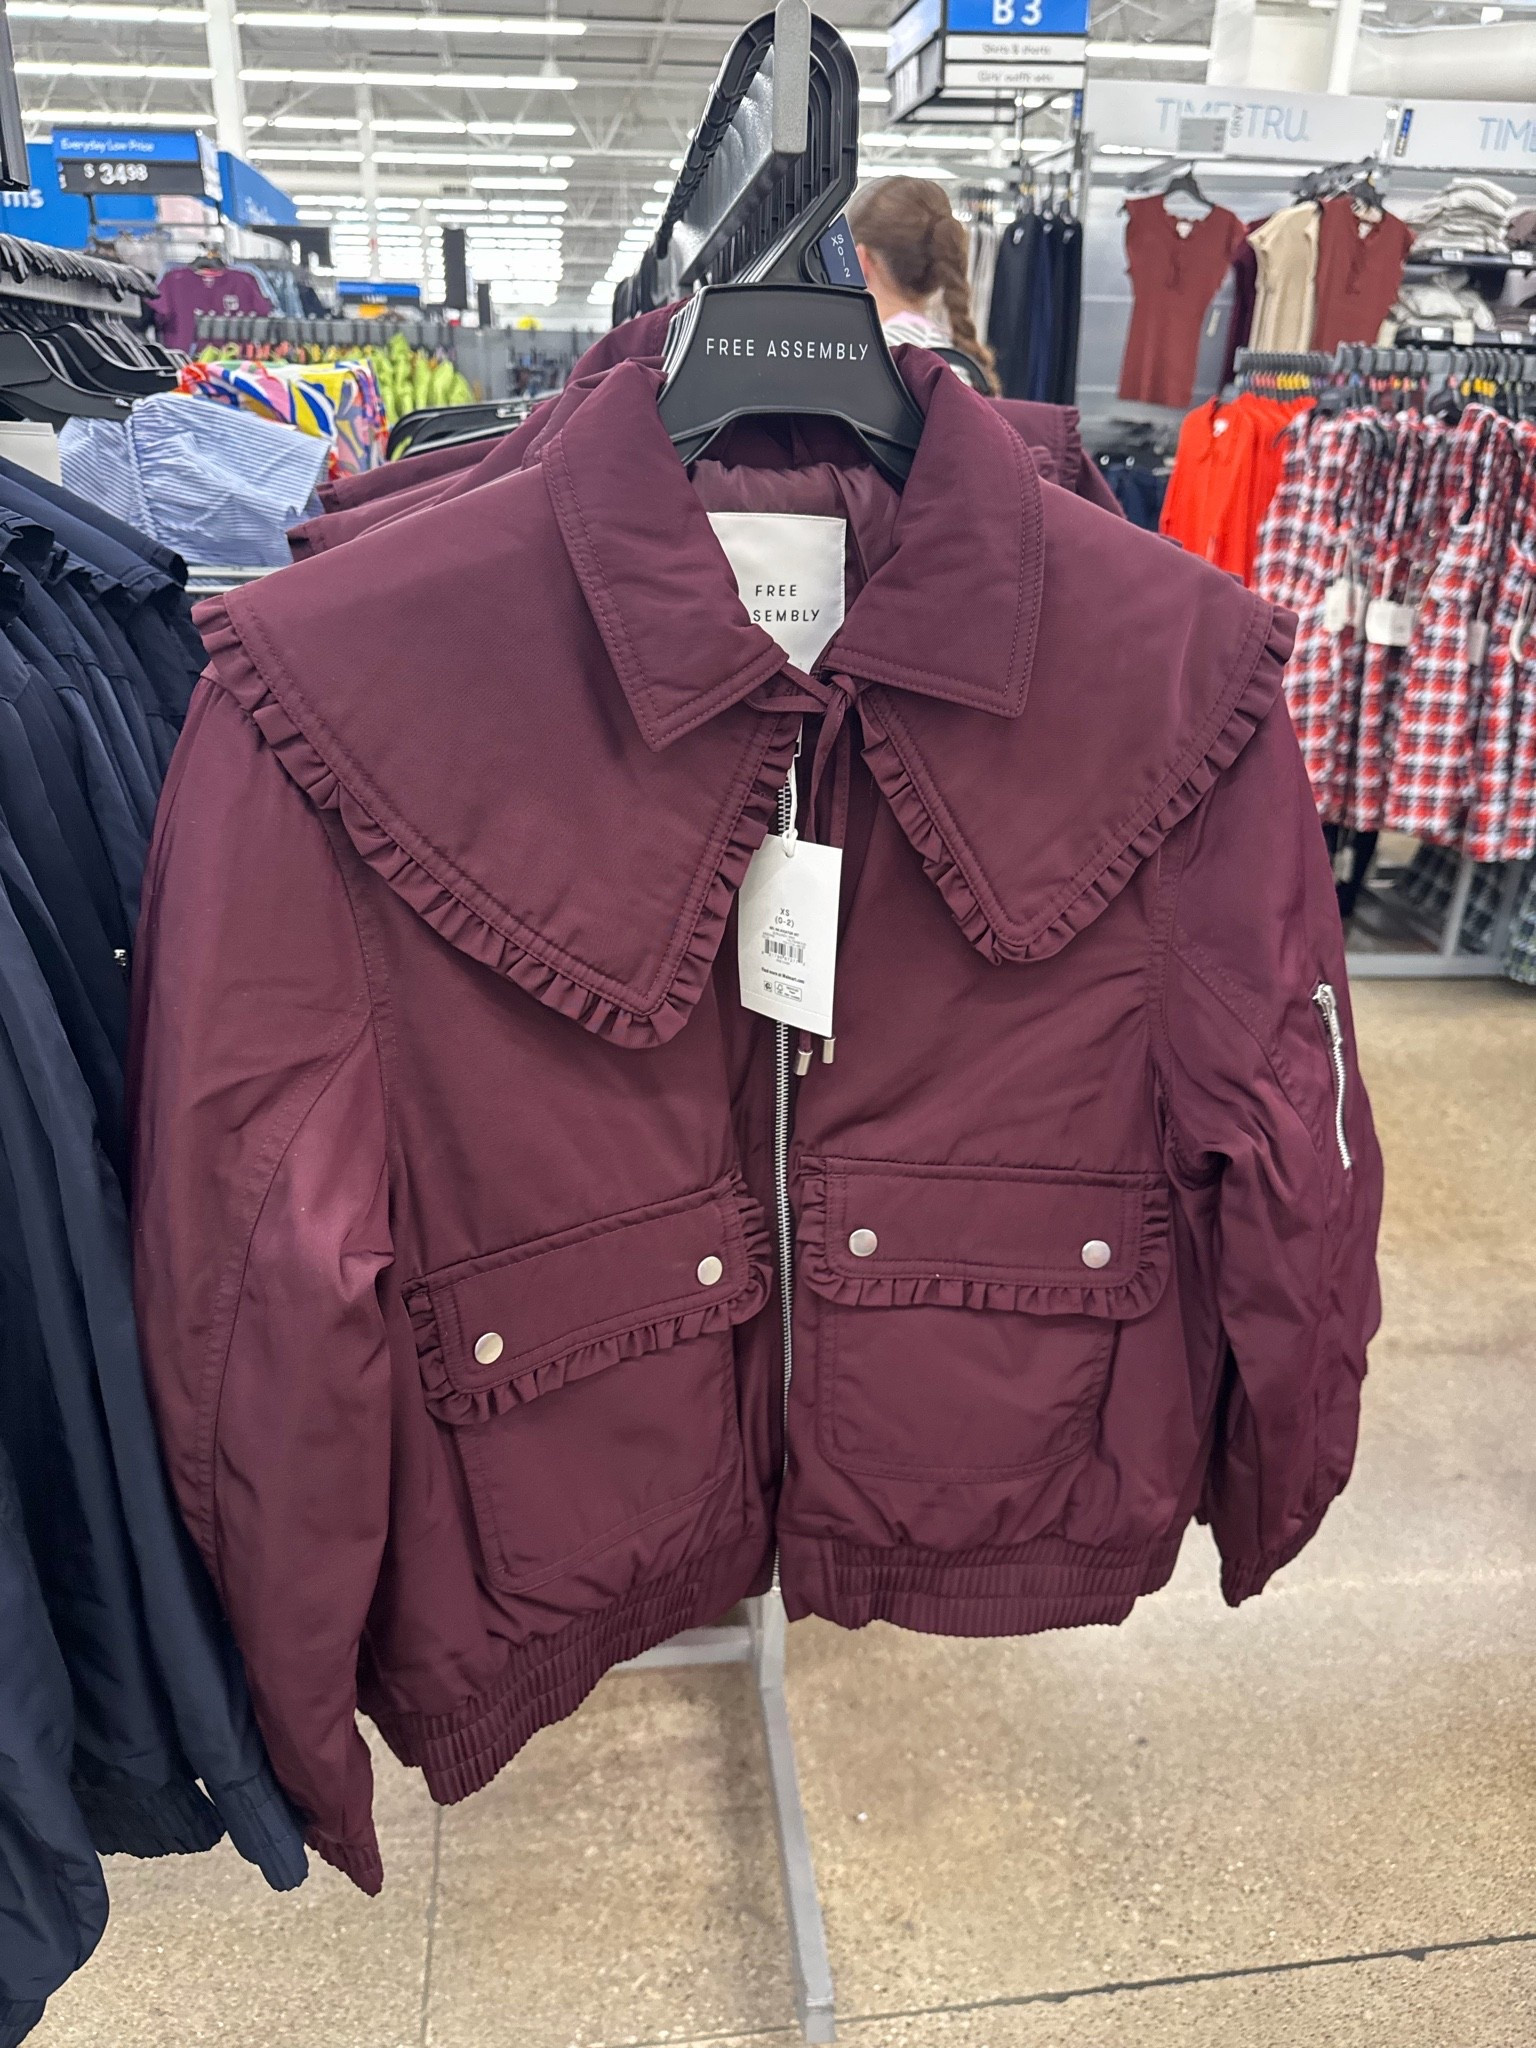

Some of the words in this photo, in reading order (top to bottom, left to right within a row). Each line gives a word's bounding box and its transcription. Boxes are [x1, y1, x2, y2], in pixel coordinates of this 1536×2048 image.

[60, 138, 106, 154] Everyday
[107, 138, 127, 152] Low
[128, 139, 155, 152] Price
[83, 163, 96, 179] $
[831, 233, 845, 247] XS
[706, 338, 755, 356] FREE
[766, 340, 869, 361] ASSEMBLY
[755, 584, 797, 597] FREE
[752, 609, 820, 622] SEMBLY
[780, 907, 790, 917] XS
[775, 915, 795, 929] (0-2)
